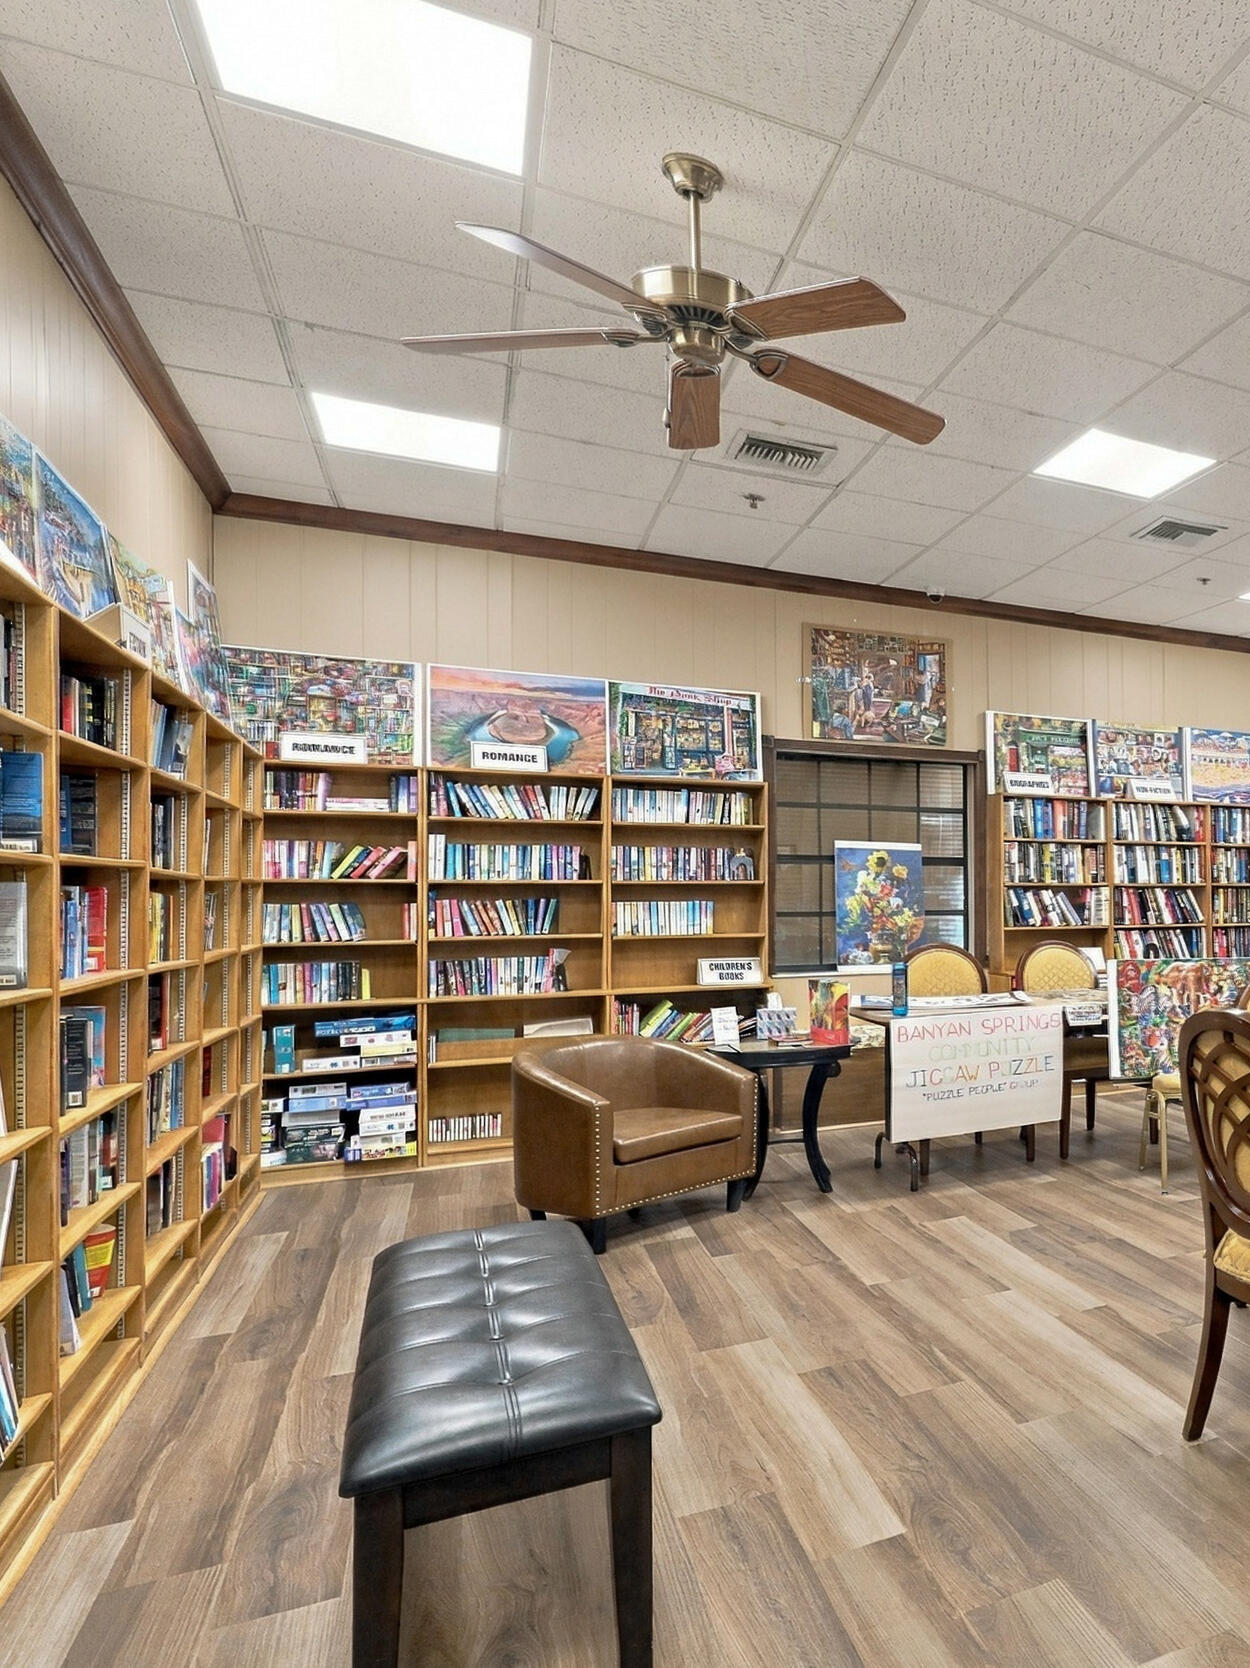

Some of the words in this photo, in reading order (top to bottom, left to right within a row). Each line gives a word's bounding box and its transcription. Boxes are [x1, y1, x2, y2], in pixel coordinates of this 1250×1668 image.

[482, 751, 538, 764] ROMANCE
[709, 962, 753, 972] CHILDREN'S
[719, 972, 744, 981] BOOKS
[897, 1020, 971, 1043] BANYAN
[981, 1012, 1061, 1035] SPRINGS
